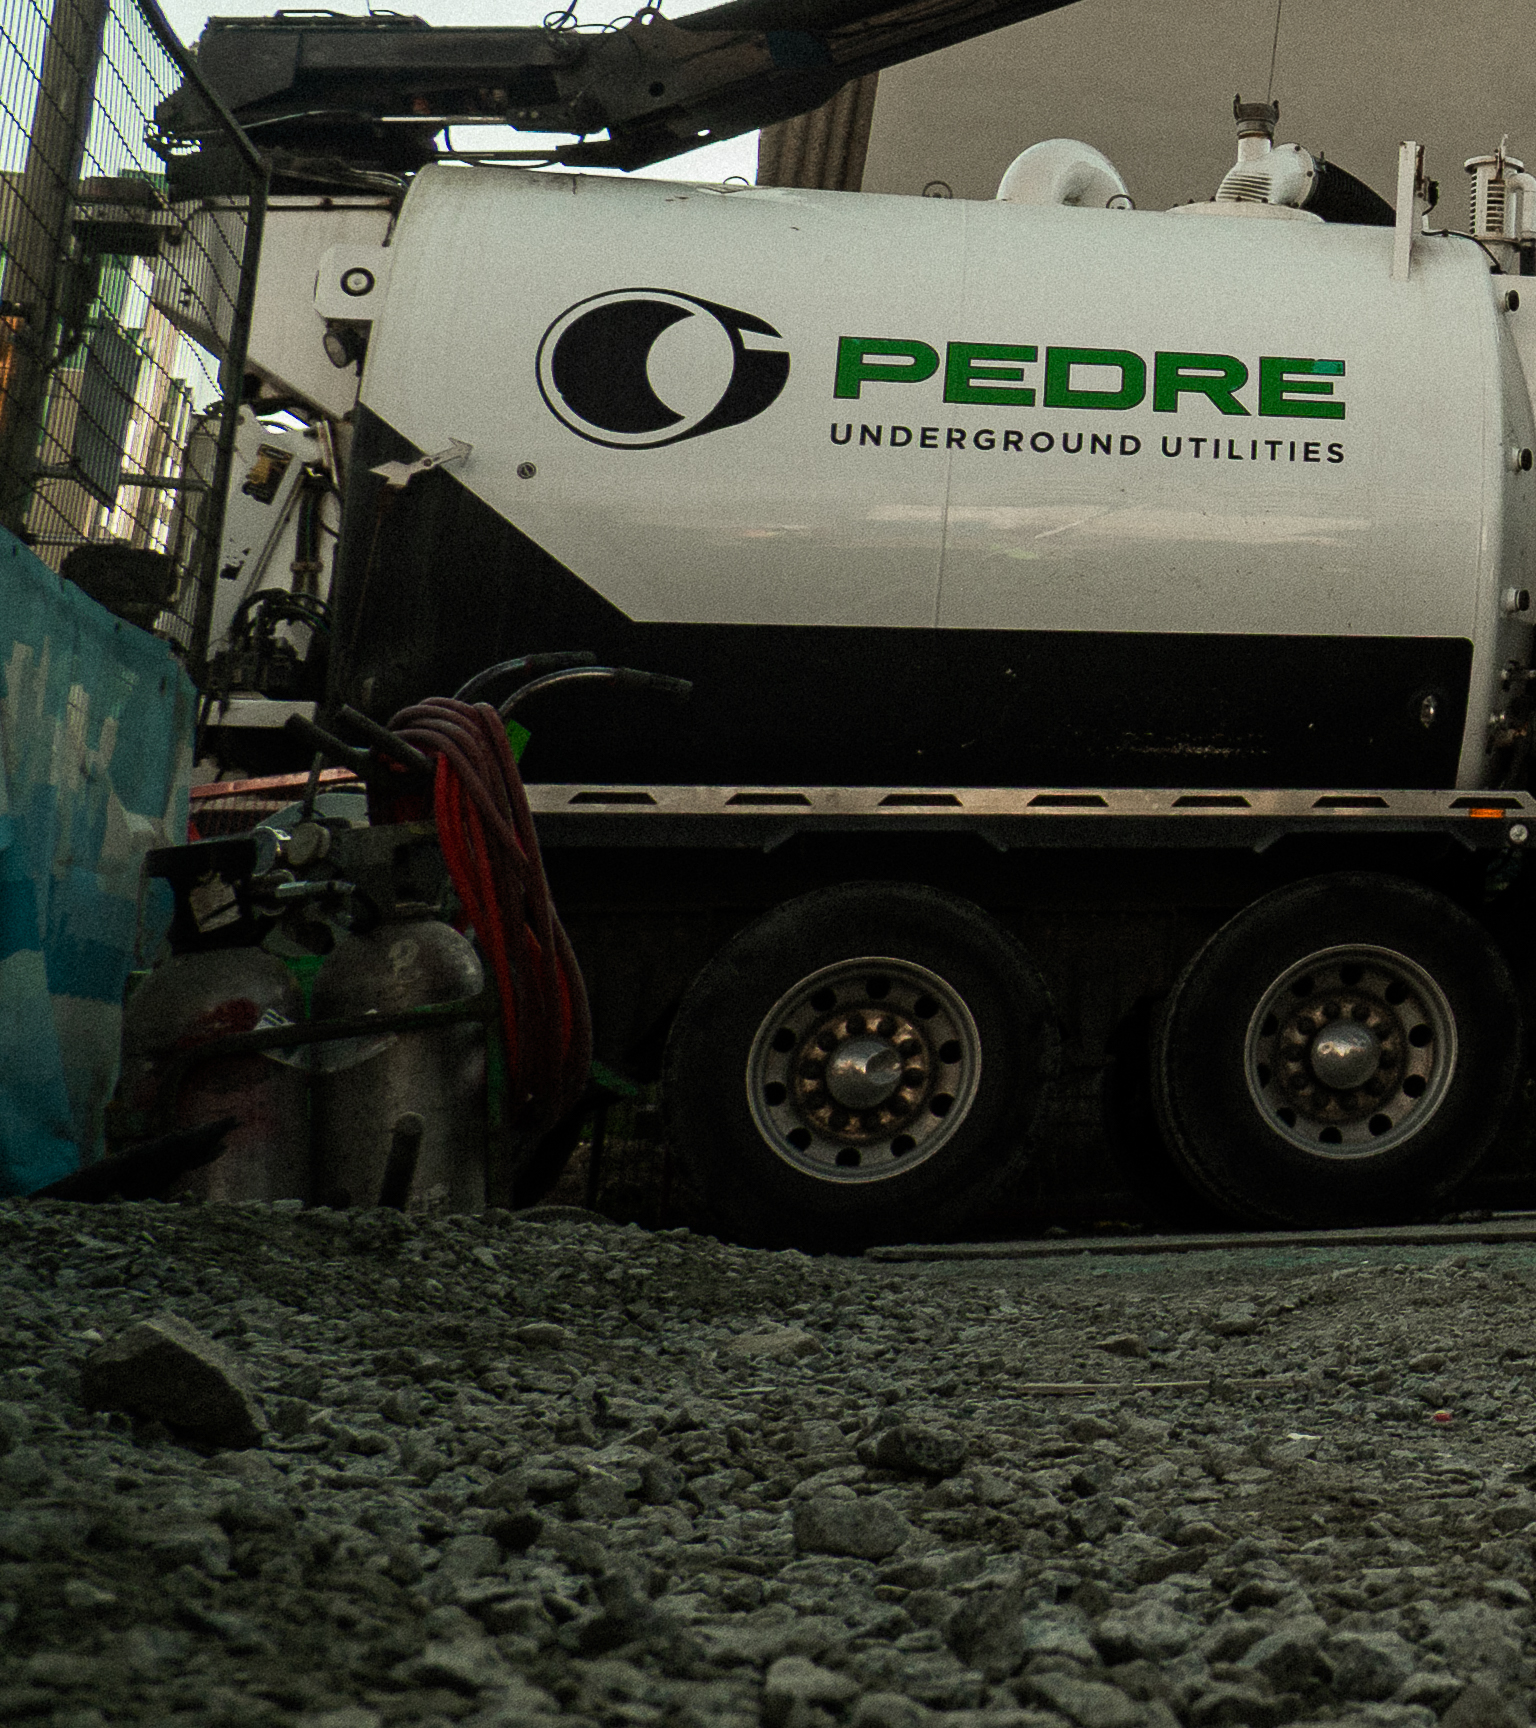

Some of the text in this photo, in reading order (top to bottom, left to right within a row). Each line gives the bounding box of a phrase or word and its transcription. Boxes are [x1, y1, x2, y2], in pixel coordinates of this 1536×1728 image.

[833, 336, 1346, 420] PEDRE
[830, 423, 1345, 463] UNDERGROUND UTILITIES
